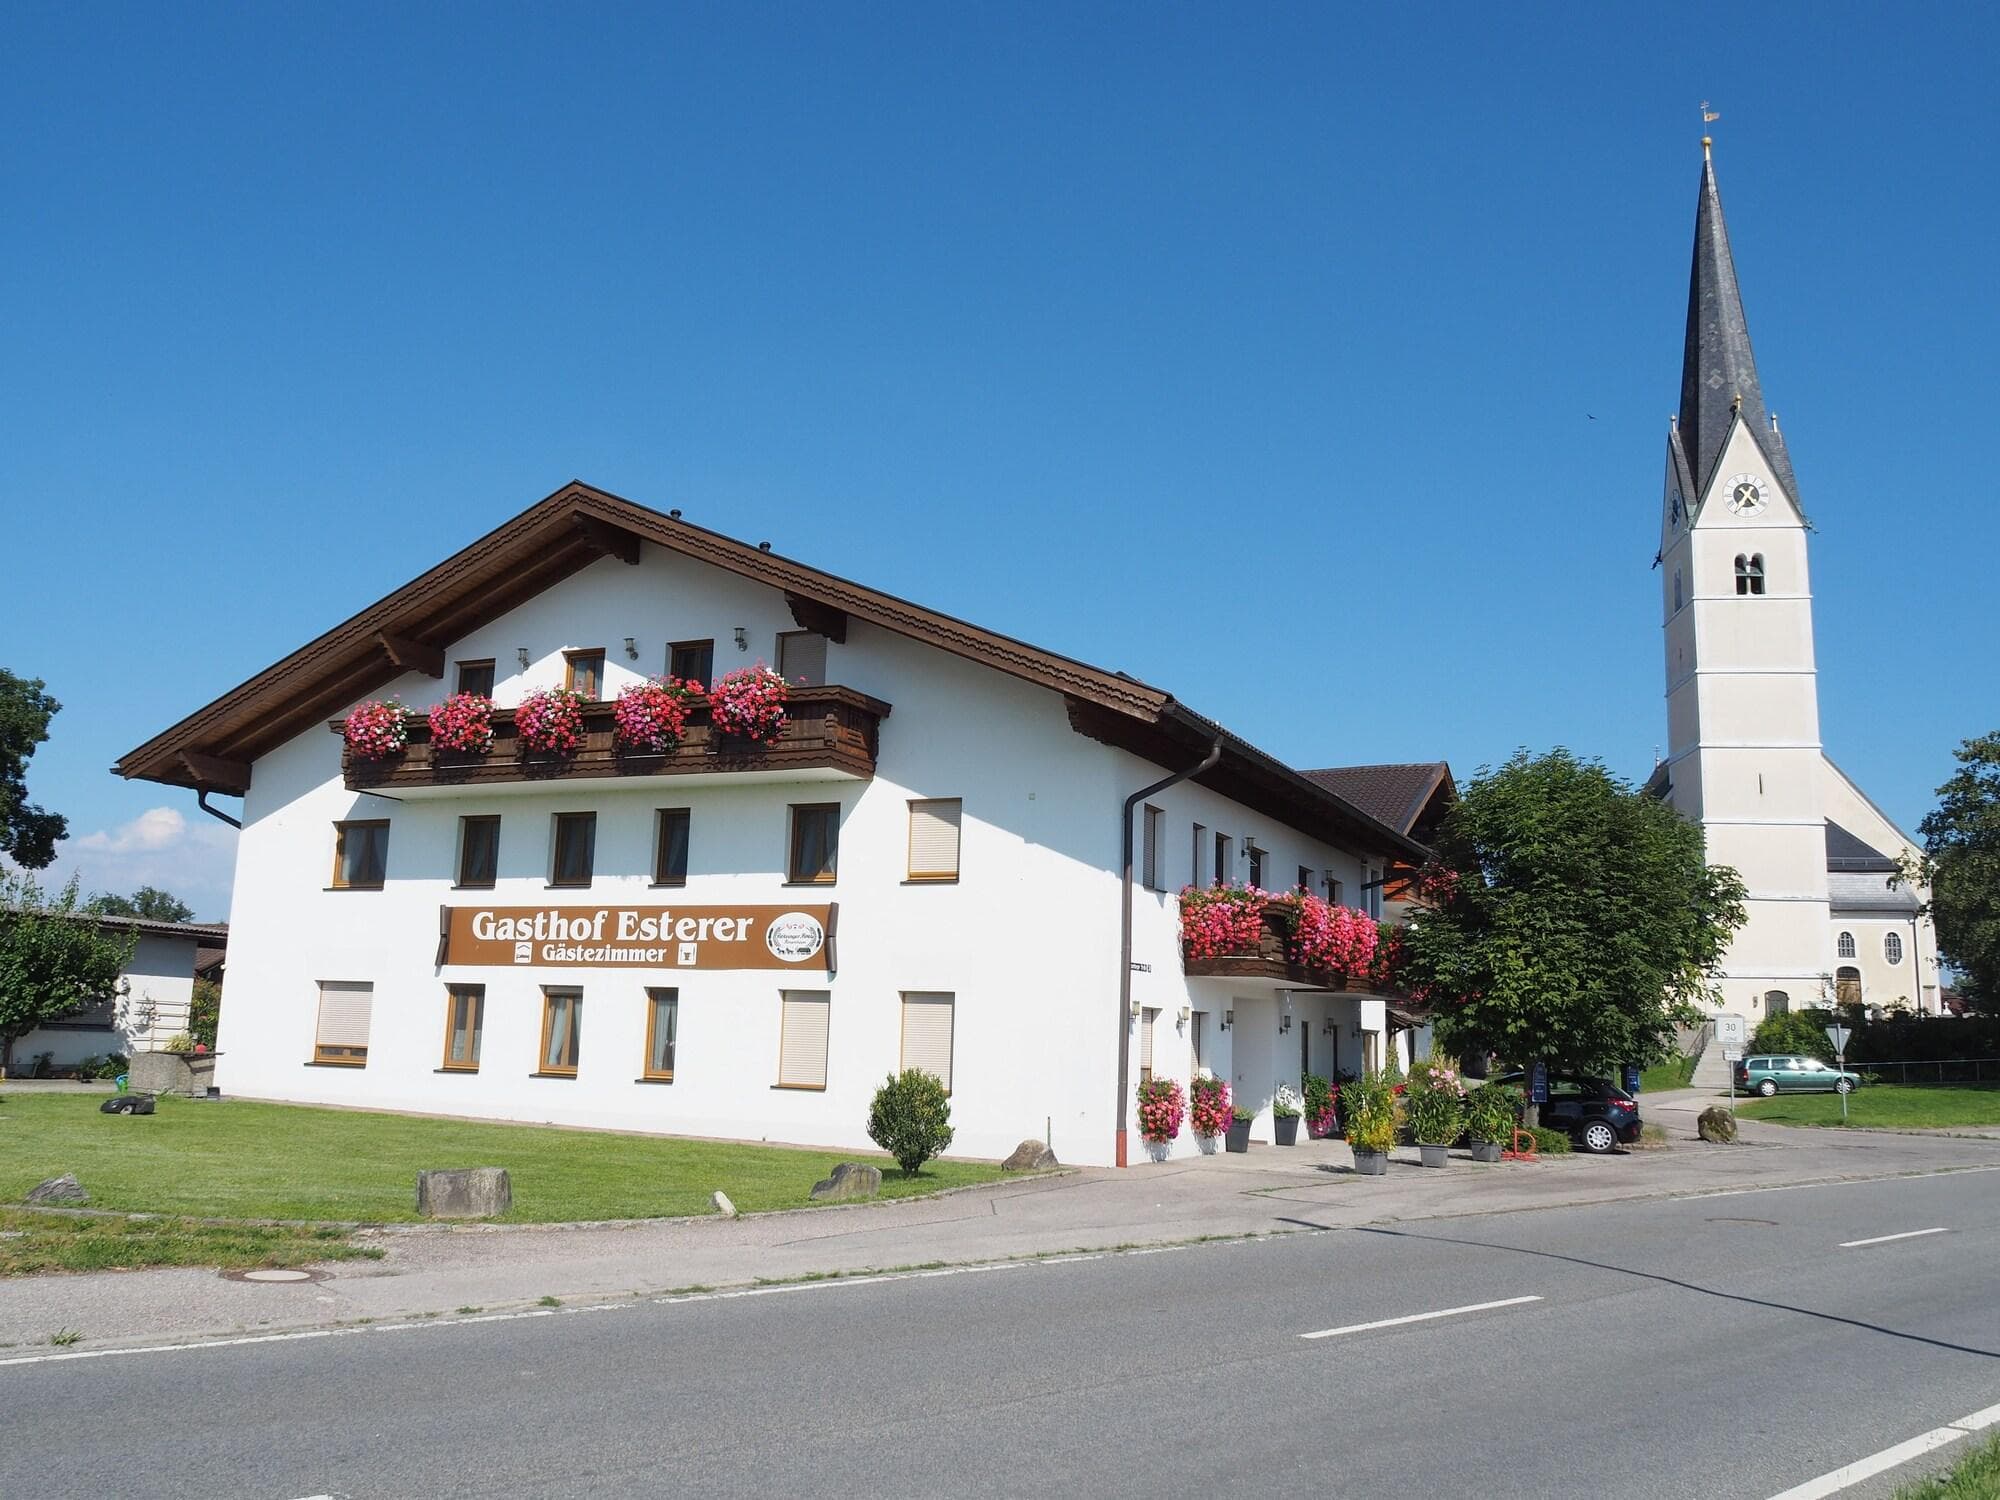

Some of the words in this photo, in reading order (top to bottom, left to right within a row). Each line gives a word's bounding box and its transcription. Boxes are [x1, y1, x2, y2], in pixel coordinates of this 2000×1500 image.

[472, 910, 609, 941] Gasthof
[616, 911, 754, 941] Esterer
[542, 943, 667, 962] Gästezimmer
[1725, 1023, 1737, 1031] 30
